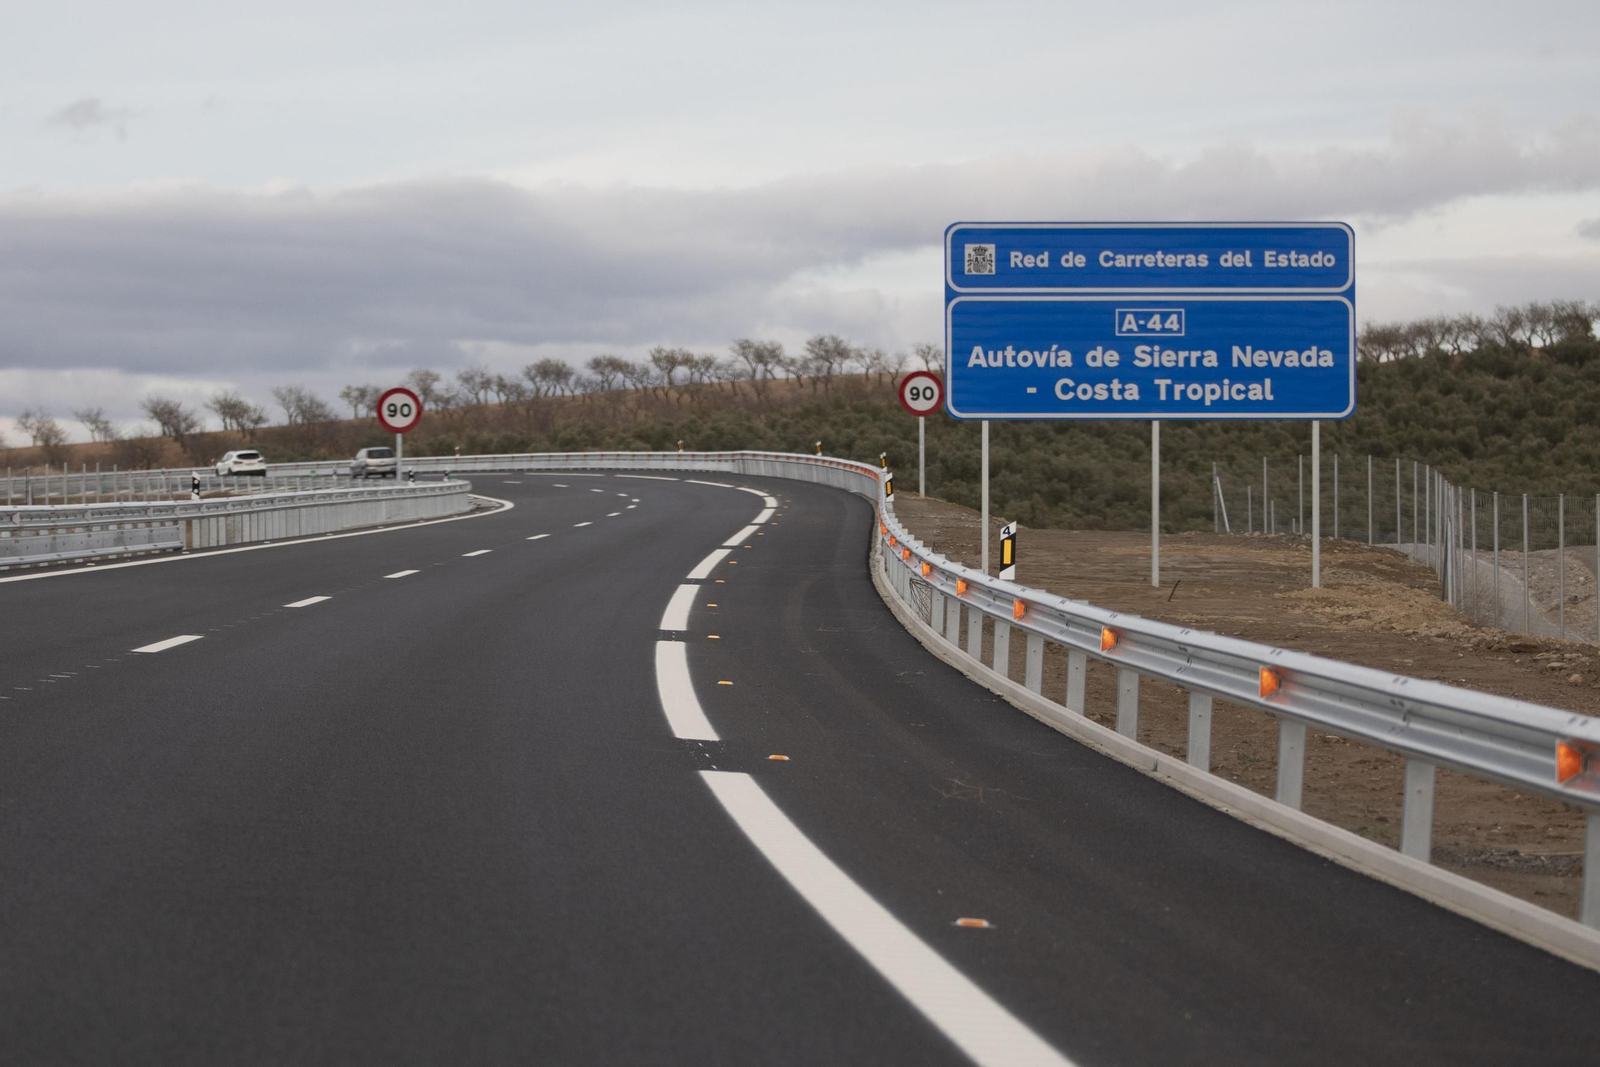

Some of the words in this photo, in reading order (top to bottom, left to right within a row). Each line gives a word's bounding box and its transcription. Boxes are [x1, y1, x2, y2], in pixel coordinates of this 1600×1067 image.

[1010, 250, 1049, 268] Red
[1060, 250, 1087, 268] de
[1098, 250, 1209, 268] Carreteras
[1219, 250, 1253, 268] del
[1264, 250, 1336, 268] Estado
[1121, 313, 1180, 332] A-44
[967, 344, 1073, 368] Autovía
[1085, 345, 1120, 368] de
[1132, 344, 1219, 368] Sierra
[1231, 345, 1335, 368] Nevada
[909, 386, 934, 401] 90
[1054, 377, 1141, 401] Costa
[1153, 377, 1274, 406] Tropical
[386, 403, 412, 418] 90
[1002, 525, 1011, 535] 4
